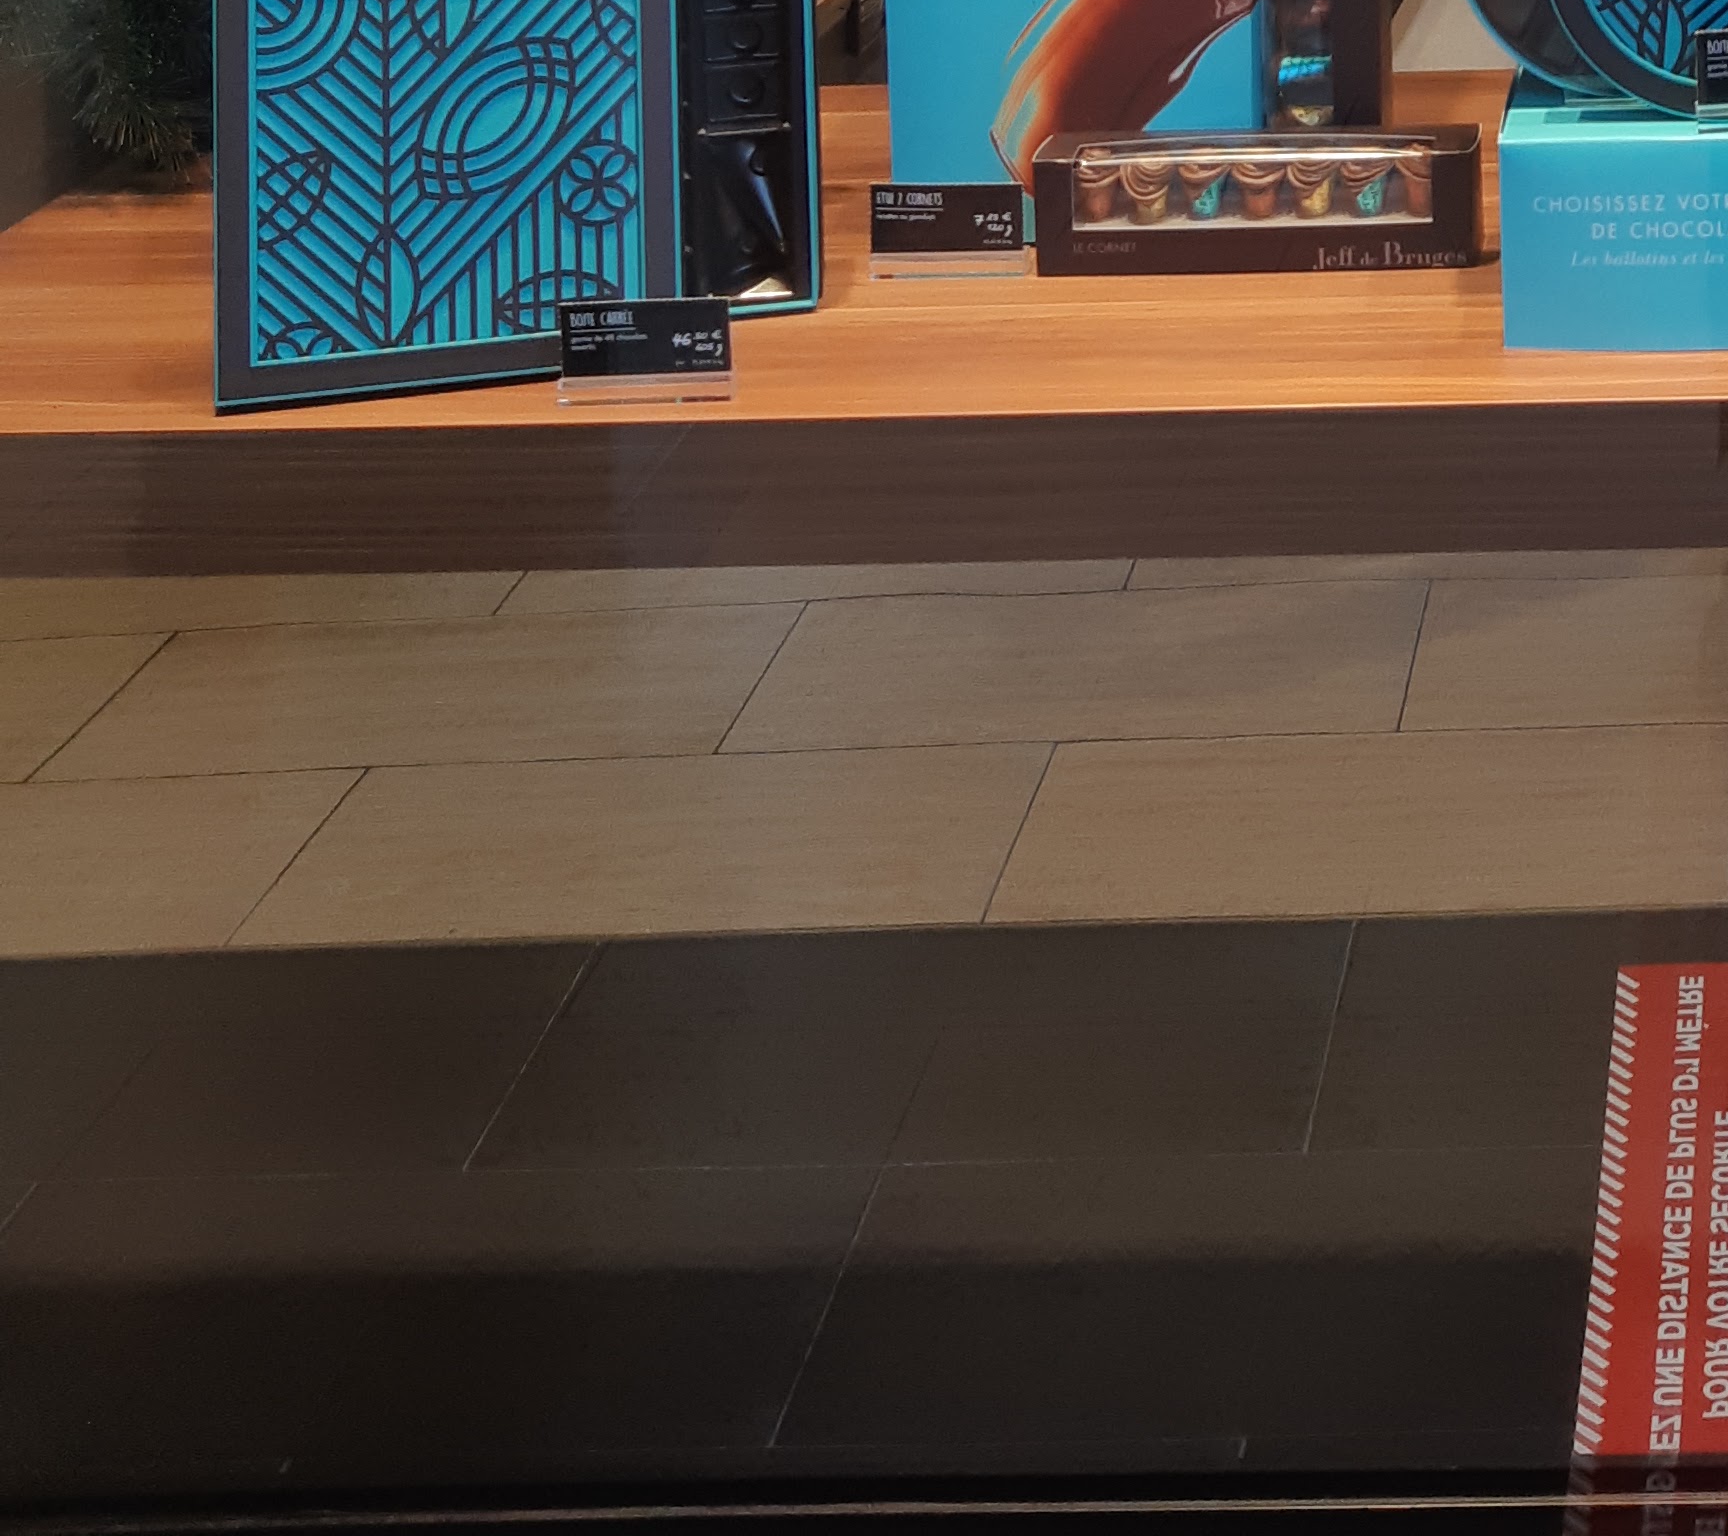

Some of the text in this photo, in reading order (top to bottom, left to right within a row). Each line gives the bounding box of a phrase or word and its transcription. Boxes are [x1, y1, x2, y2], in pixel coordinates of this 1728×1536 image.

[1534, 193, 1665, 213] CHOISISSEZ
[1591, 222, 1617, 240] DE
[1312, 245, 1358, 270] Jeff
[1380, 240, 1468, 268] Bruges
